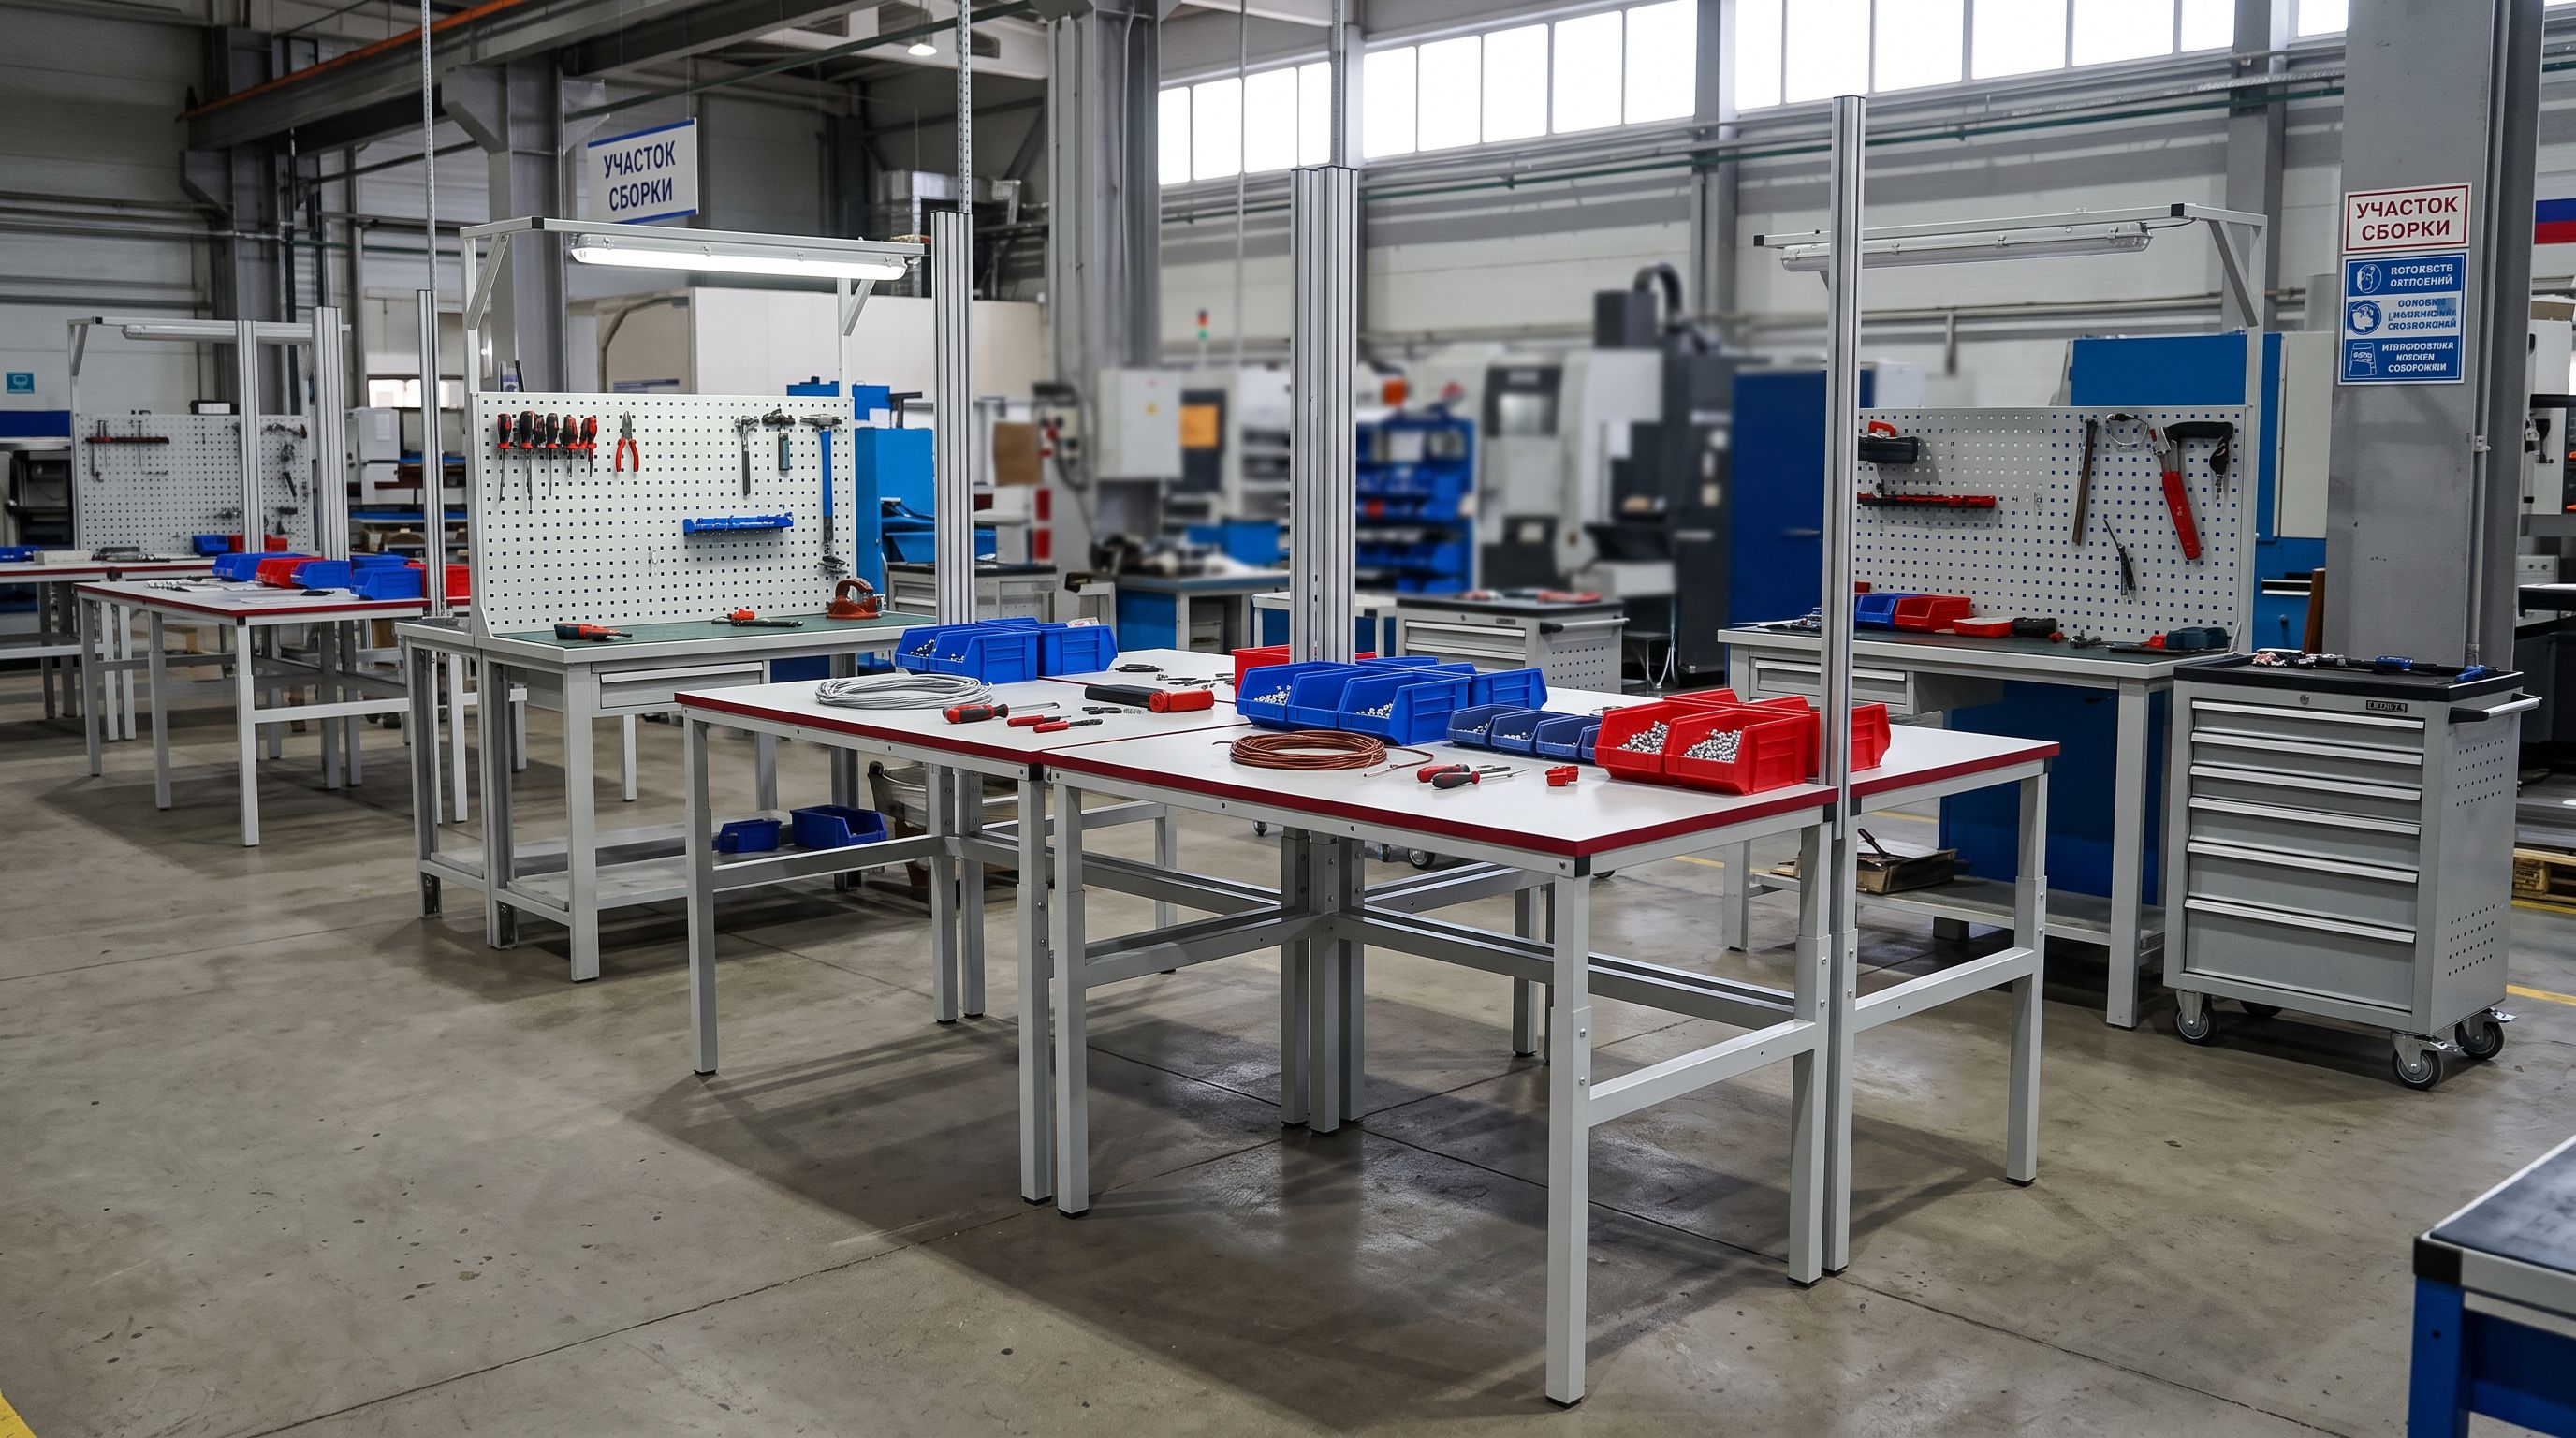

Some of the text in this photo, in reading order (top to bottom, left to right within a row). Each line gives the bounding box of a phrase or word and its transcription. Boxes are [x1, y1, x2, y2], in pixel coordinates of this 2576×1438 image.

[604, 140, 676, 179] УЧАСТОК
[609, 177, 672, 211] СБОРКИ
[2356, 196, 2458, 219] УЧАСТОК
[2362, 220, 2450, 241] СБОРКИ
